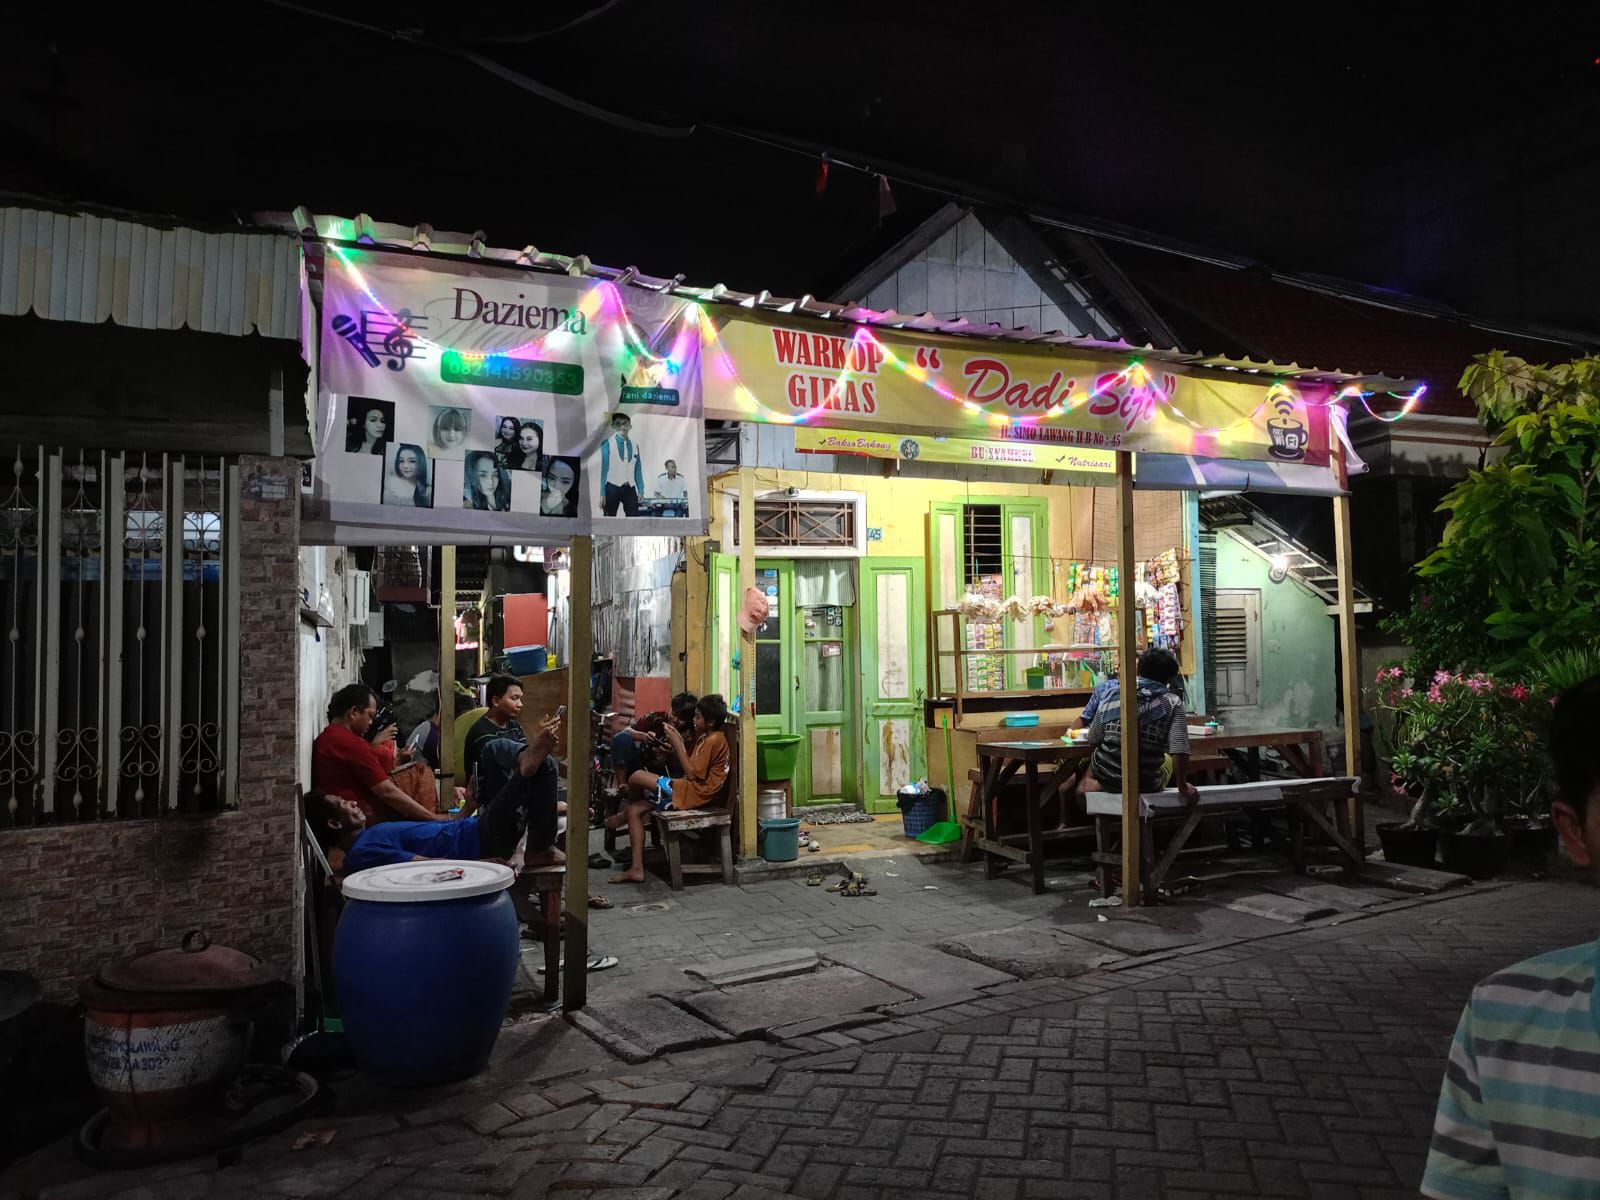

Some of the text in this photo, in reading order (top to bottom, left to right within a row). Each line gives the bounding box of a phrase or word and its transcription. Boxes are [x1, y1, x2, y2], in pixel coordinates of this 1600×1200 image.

[451, 287, 587, 335] Daziema
[772, 329, 884, 374] WARKOP
[449, 360, 578, 387] 082141590353
[964, 358, 1075, 410] Dadi
[787, 374, 876, 414] GIRAS
[970, 446, 985, 459] BU
[1014, 426, 1037, 440] SIMO
[1039, 427, 1074, 443] LAWANG
[1111, 434, 1121, 447] 45
[869, 529, 882, 540] 45
